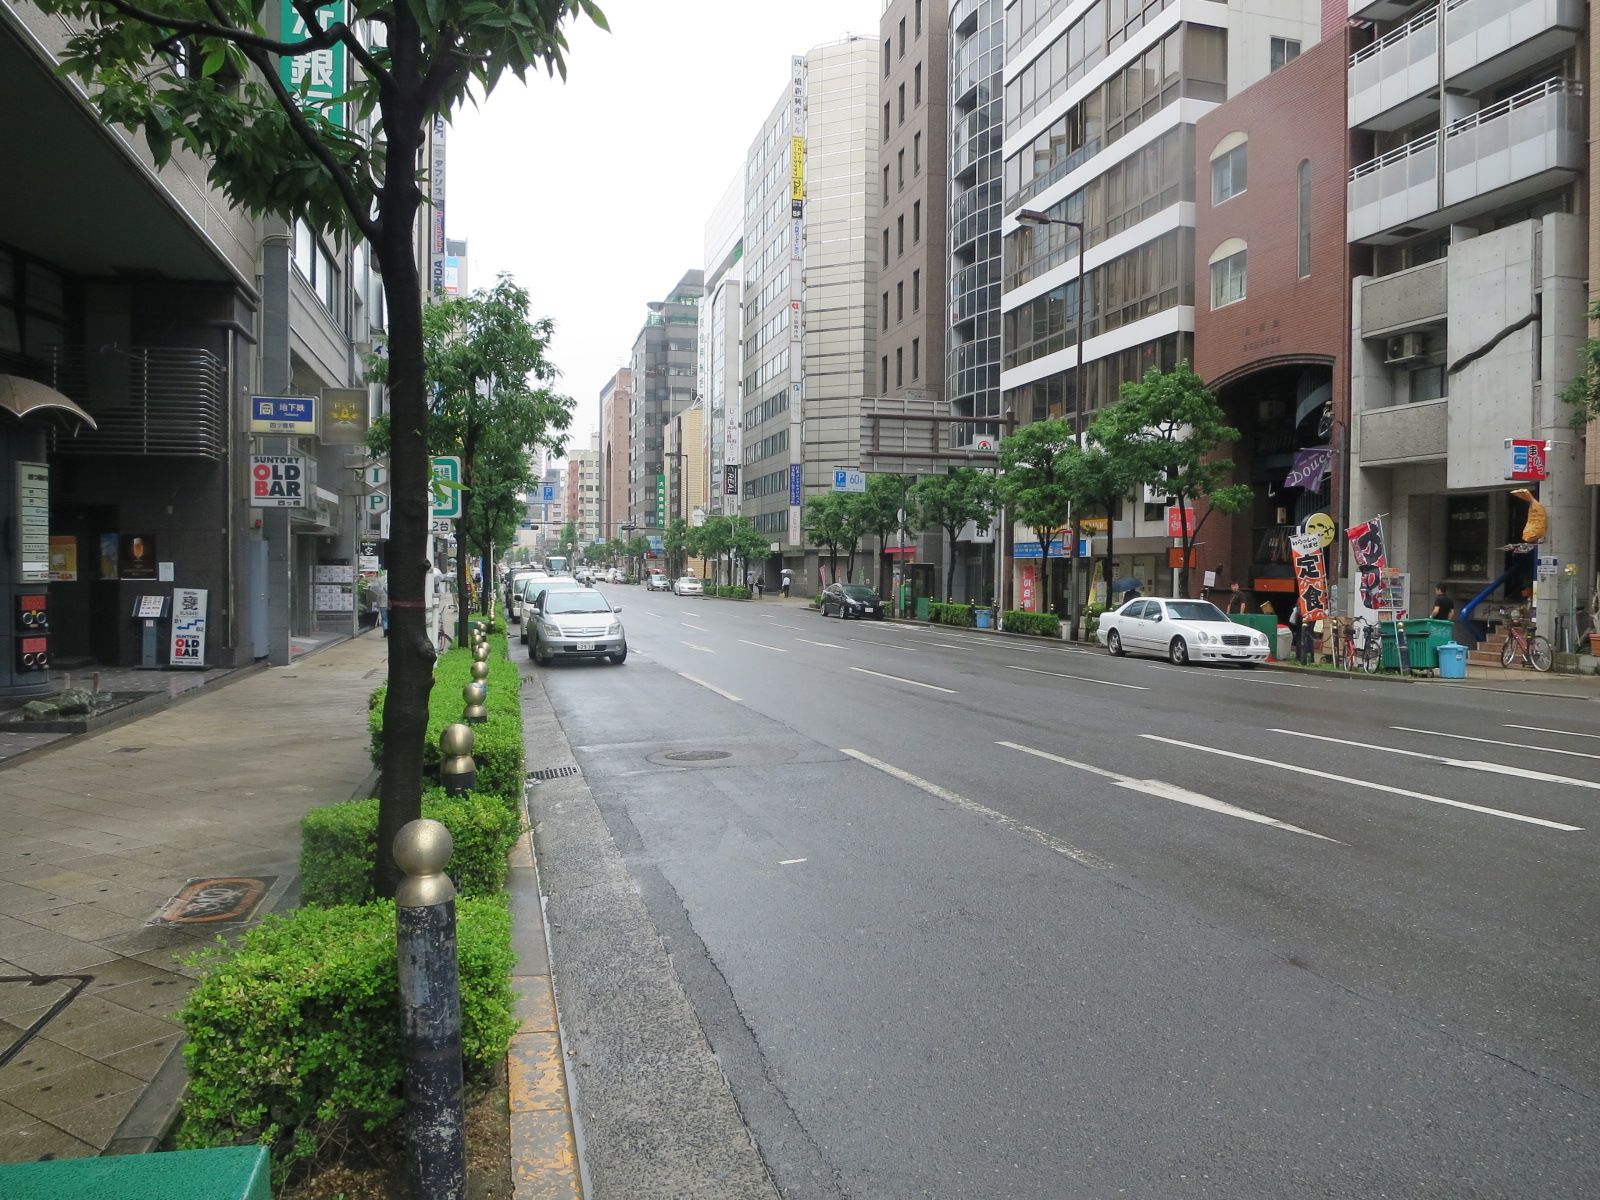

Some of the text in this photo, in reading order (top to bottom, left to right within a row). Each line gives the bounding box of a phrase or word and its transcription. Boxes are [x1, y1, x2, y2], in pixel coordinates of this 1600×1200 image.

[279, 403, 305, 412] 地下鉄
[253, 456, 300, 464] SUNTORY
[253, 464, 301, 480] OLD
[1286, 449, 1334, 487] Douce
[254, 481, 301, 497] BAR
[370, 495, 384, 510] P
[1296, 554, 1325, 612] 定食
[175, 639, 200, 648] OLD
[175, 648, 199, 657] BAR
